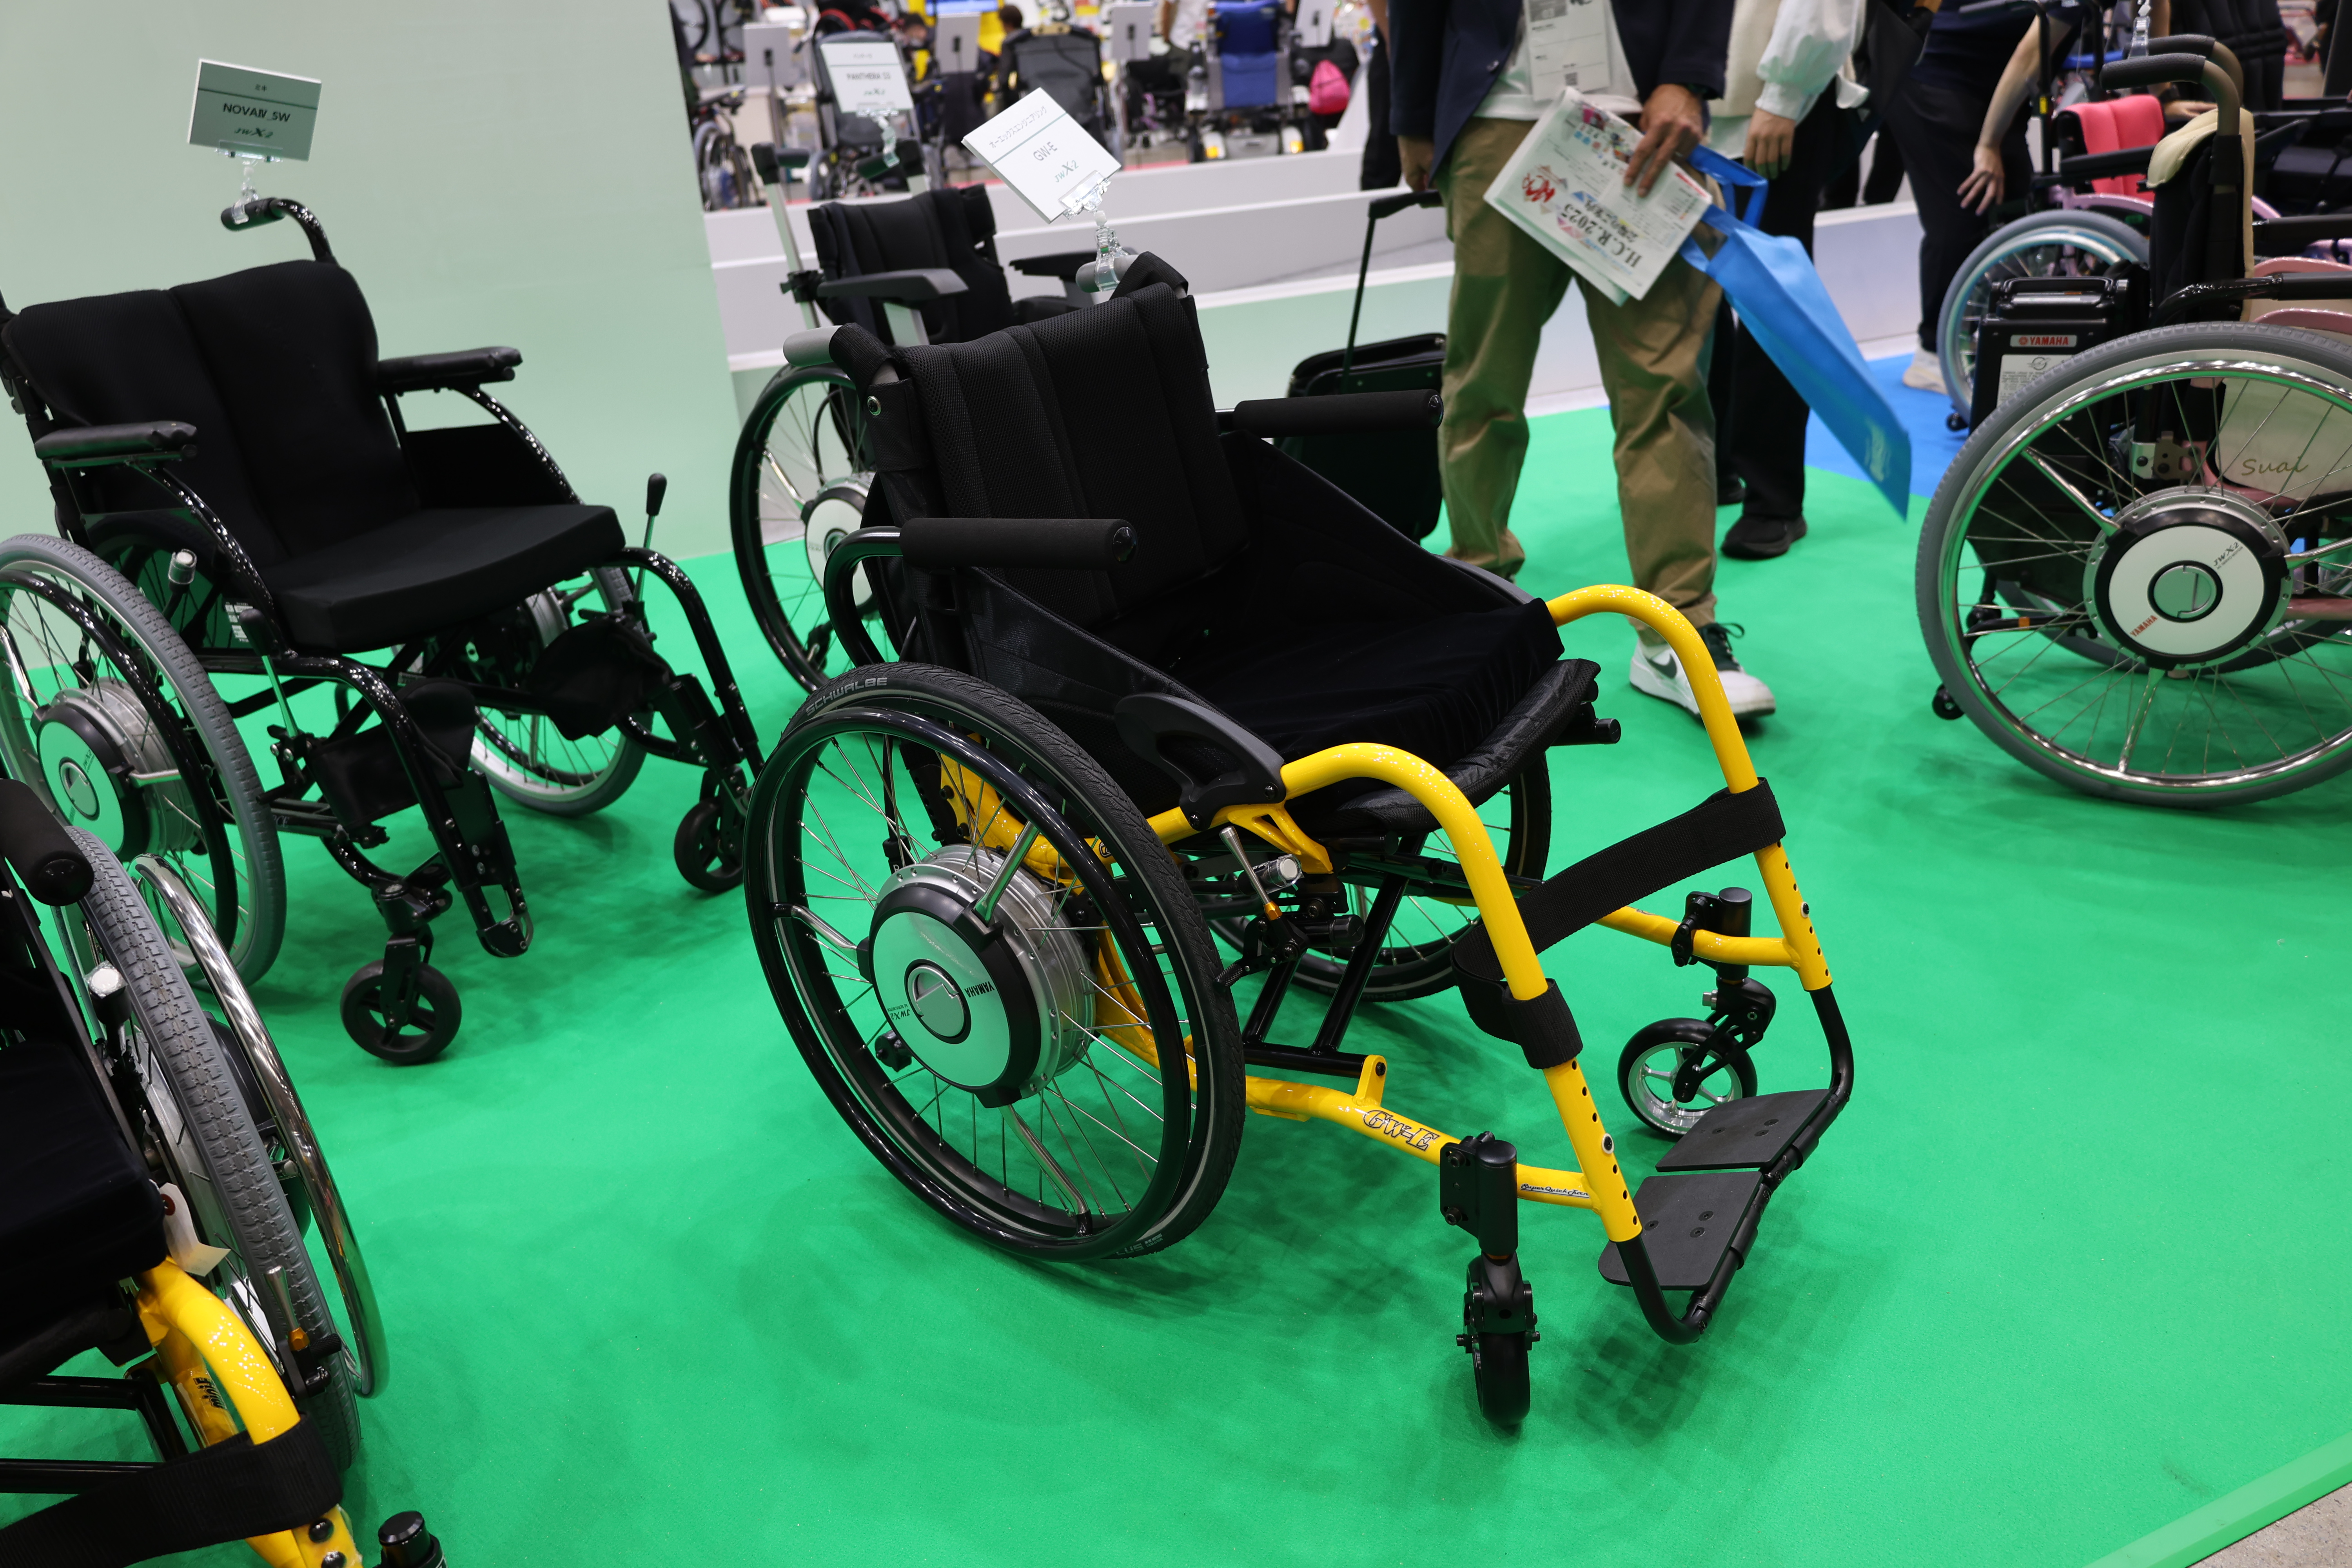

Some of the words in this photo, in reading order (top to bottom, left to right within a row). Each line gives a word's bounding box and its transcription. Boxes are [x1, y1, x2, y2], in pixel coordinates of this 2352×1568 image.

[989, 105, 1047, 149] オーエックスエンジニアリング
[1033, 141, 1058, 161] GW-E
[1054, 160, 1079, 183] JWX-2
[2030, 336, 2069, 345] YAMAHA
[2130, 615, 2158, 637] YAMAHA
[806, 677, 888, 717] SCHWALBE
[964, 981, 995, 998] YAMAHA
[890, 1009, 910, 1020] JWX-2
[1363, 1110, 1441, 1152] GW-E
[1116, 1243, 1144, 1256] LUS
